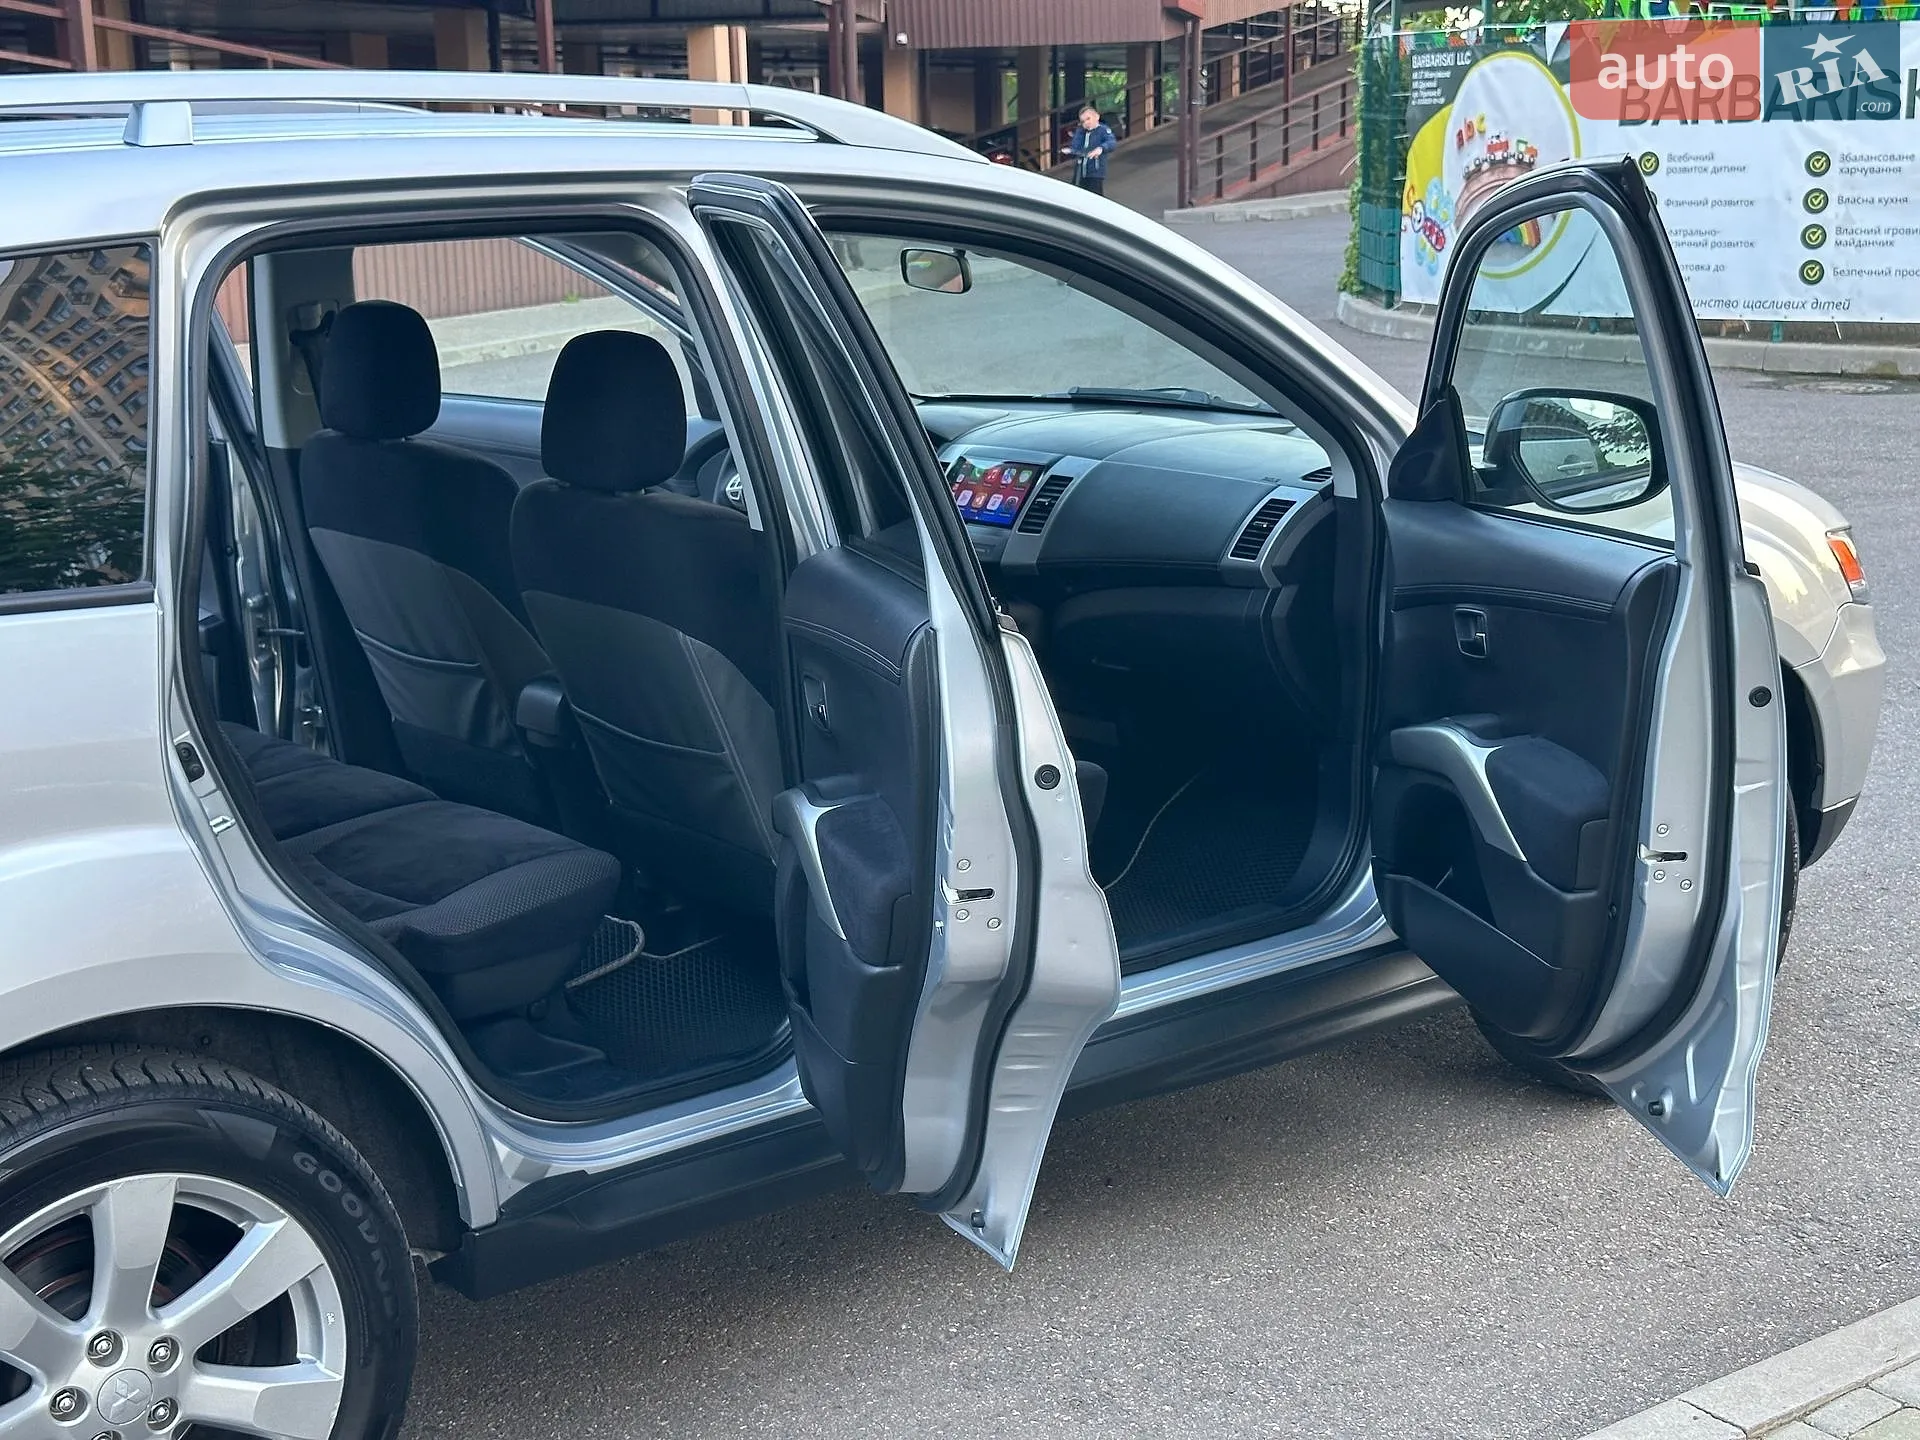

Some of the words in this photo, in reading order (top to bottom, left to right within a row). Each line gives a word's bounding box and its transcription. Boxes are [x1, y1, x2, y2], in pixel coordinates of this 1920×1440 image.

[1840, 152, 1915, 163] Збалансоване
[1666, 166, 1708, 176] розвиток
[1711, 165, 1747, 175] дитини
[1839, 166, 1902, 176] харчування
[1711, 199, 1754, 209] розвиток
[1837, 196, 1875, 205] Власна
[1878, 197, 1909, 207] кухня
[1835, 226, 1880, 236] Власний
[1884, 227, 1920, 237] ігрови
[1672, 239, 1708, 248] зичний
[1710, 241, 1756, 250] розвиток
[1834, 238, 1894, 248] майданчик
[1712, 264, 1725, 272] до
[1833, 267, 1891, 277] Безпечний
[1693, 299, 1739, 309] инство
[1743, 299, 1807, 310] щасливих
[1811, 298, 1851, 310] дітей
